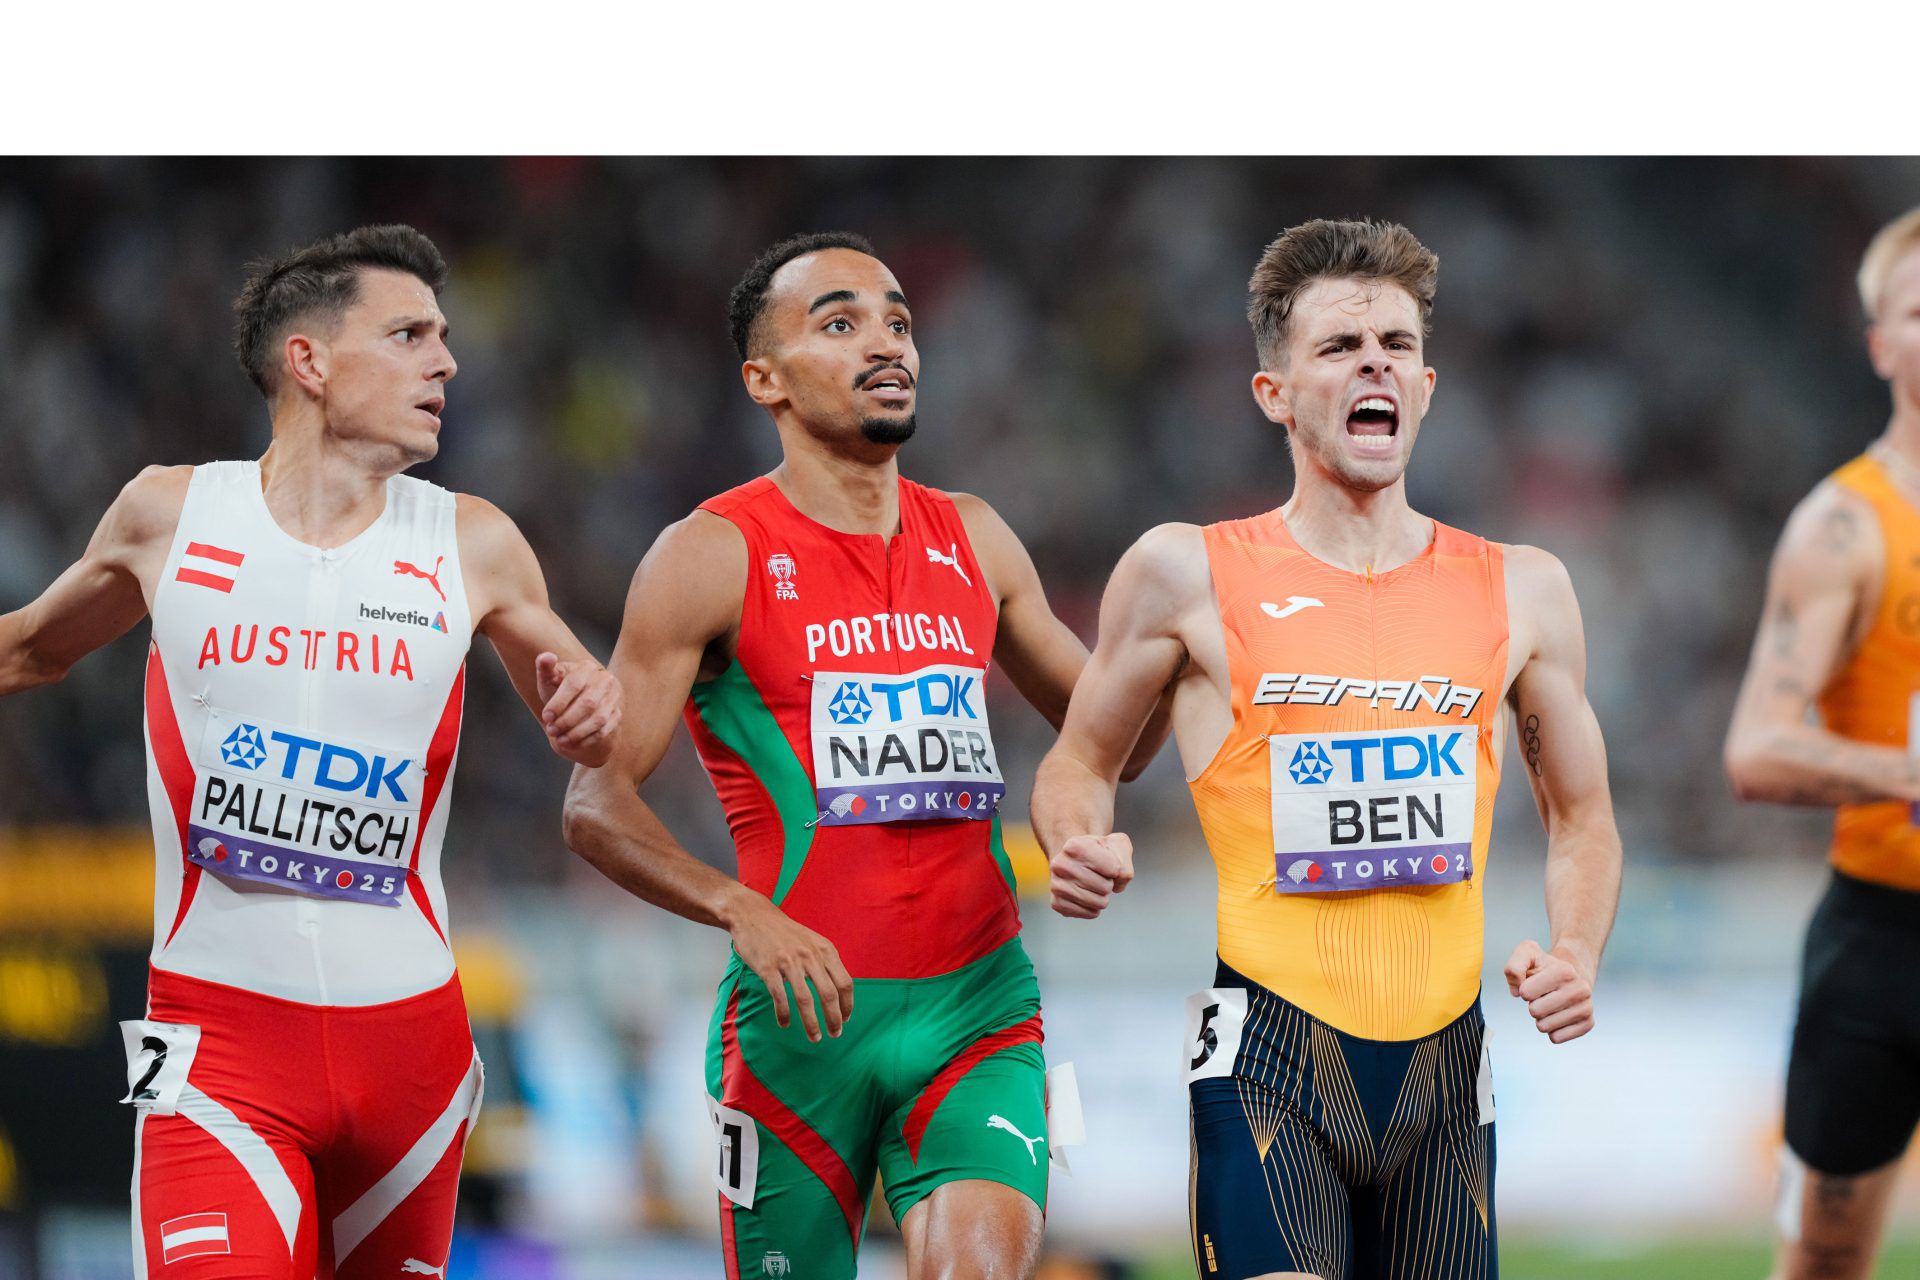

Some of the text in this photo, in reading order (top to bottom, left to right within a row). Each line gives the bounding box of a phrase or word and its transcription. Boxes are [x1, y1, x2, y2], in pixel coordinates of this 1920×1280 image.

[359, 603, 429, 627] helvetia
[776, 590, 799, 600] FPA
[198, 624, 414, 681] AUSTRIA
[805, 612, 974, 662] PORTUGAL
[872, 673, 977, 723] TDK
[1251, 673, 1484, 718] ESPAÑA
[270, 730, 411, 803] TDK
[829, 729, 992, 778] NADER
[1331, 732, 1464, 783] TDK
[202, 776, 409, 860] PALLITSCH
[1329, 793, 1444, 845] BEN
[1190, 1003, 1220, 1071] 5
[131, 1036, 168, 1101] 2
